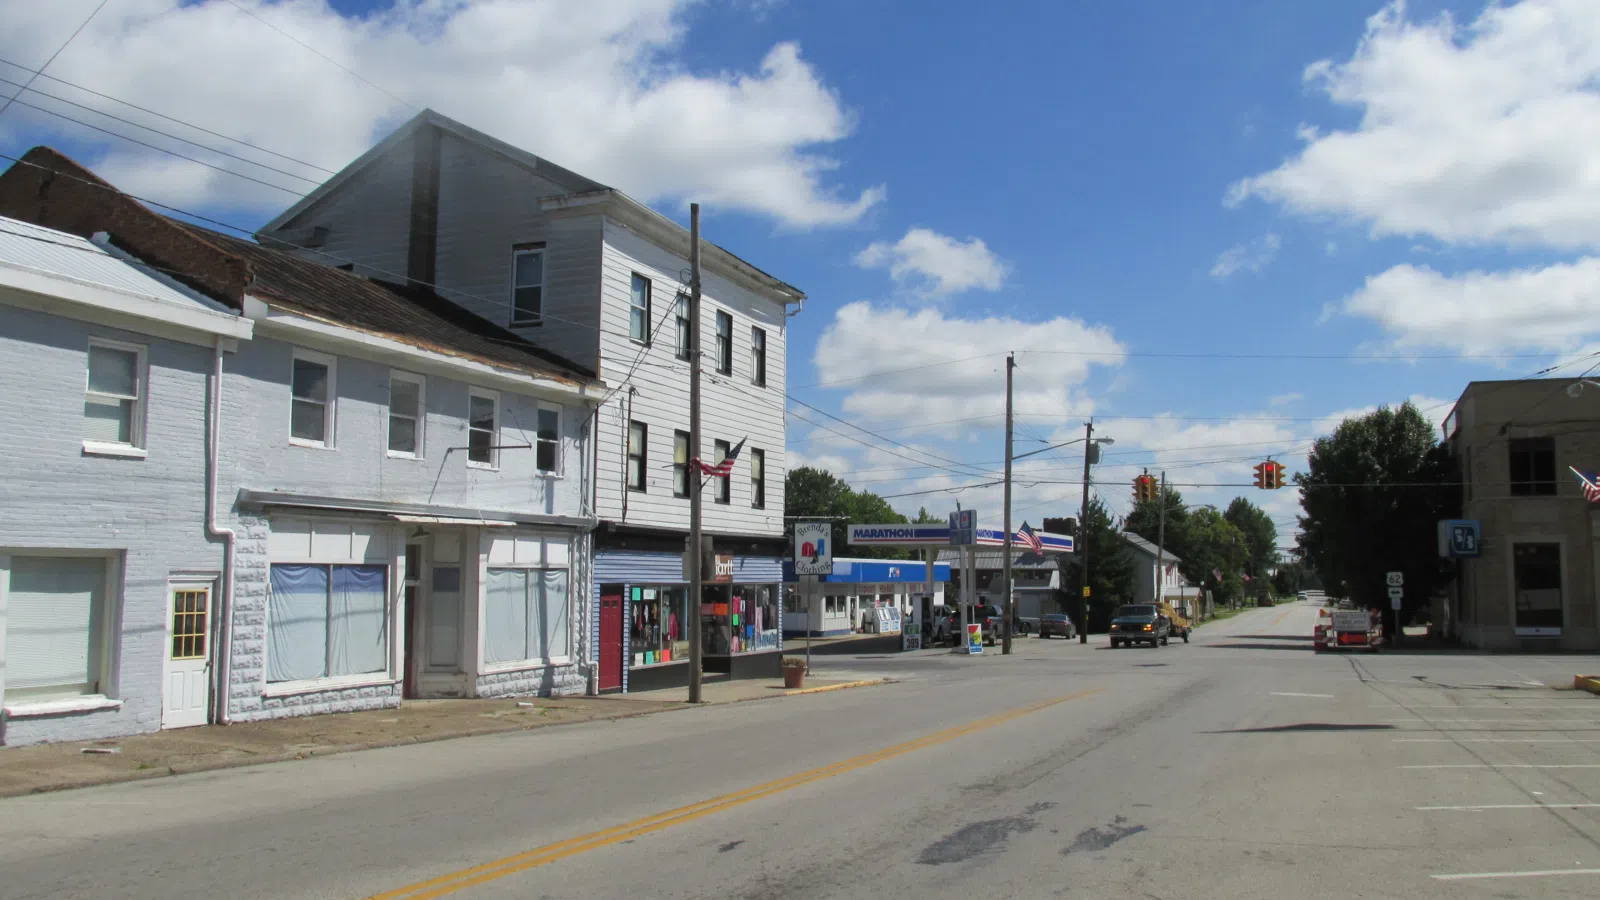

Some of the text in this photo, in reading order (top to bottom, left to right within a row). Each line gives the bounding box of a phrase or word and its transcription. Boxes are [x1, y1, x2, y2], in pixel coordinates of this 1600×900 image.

[797, 524, 829, 537] Brenda's
[853, 528, 914, 538] MARATHON
[796, 560, 831, 574] Clothing
[1390, 574, 1401, 584] 62
